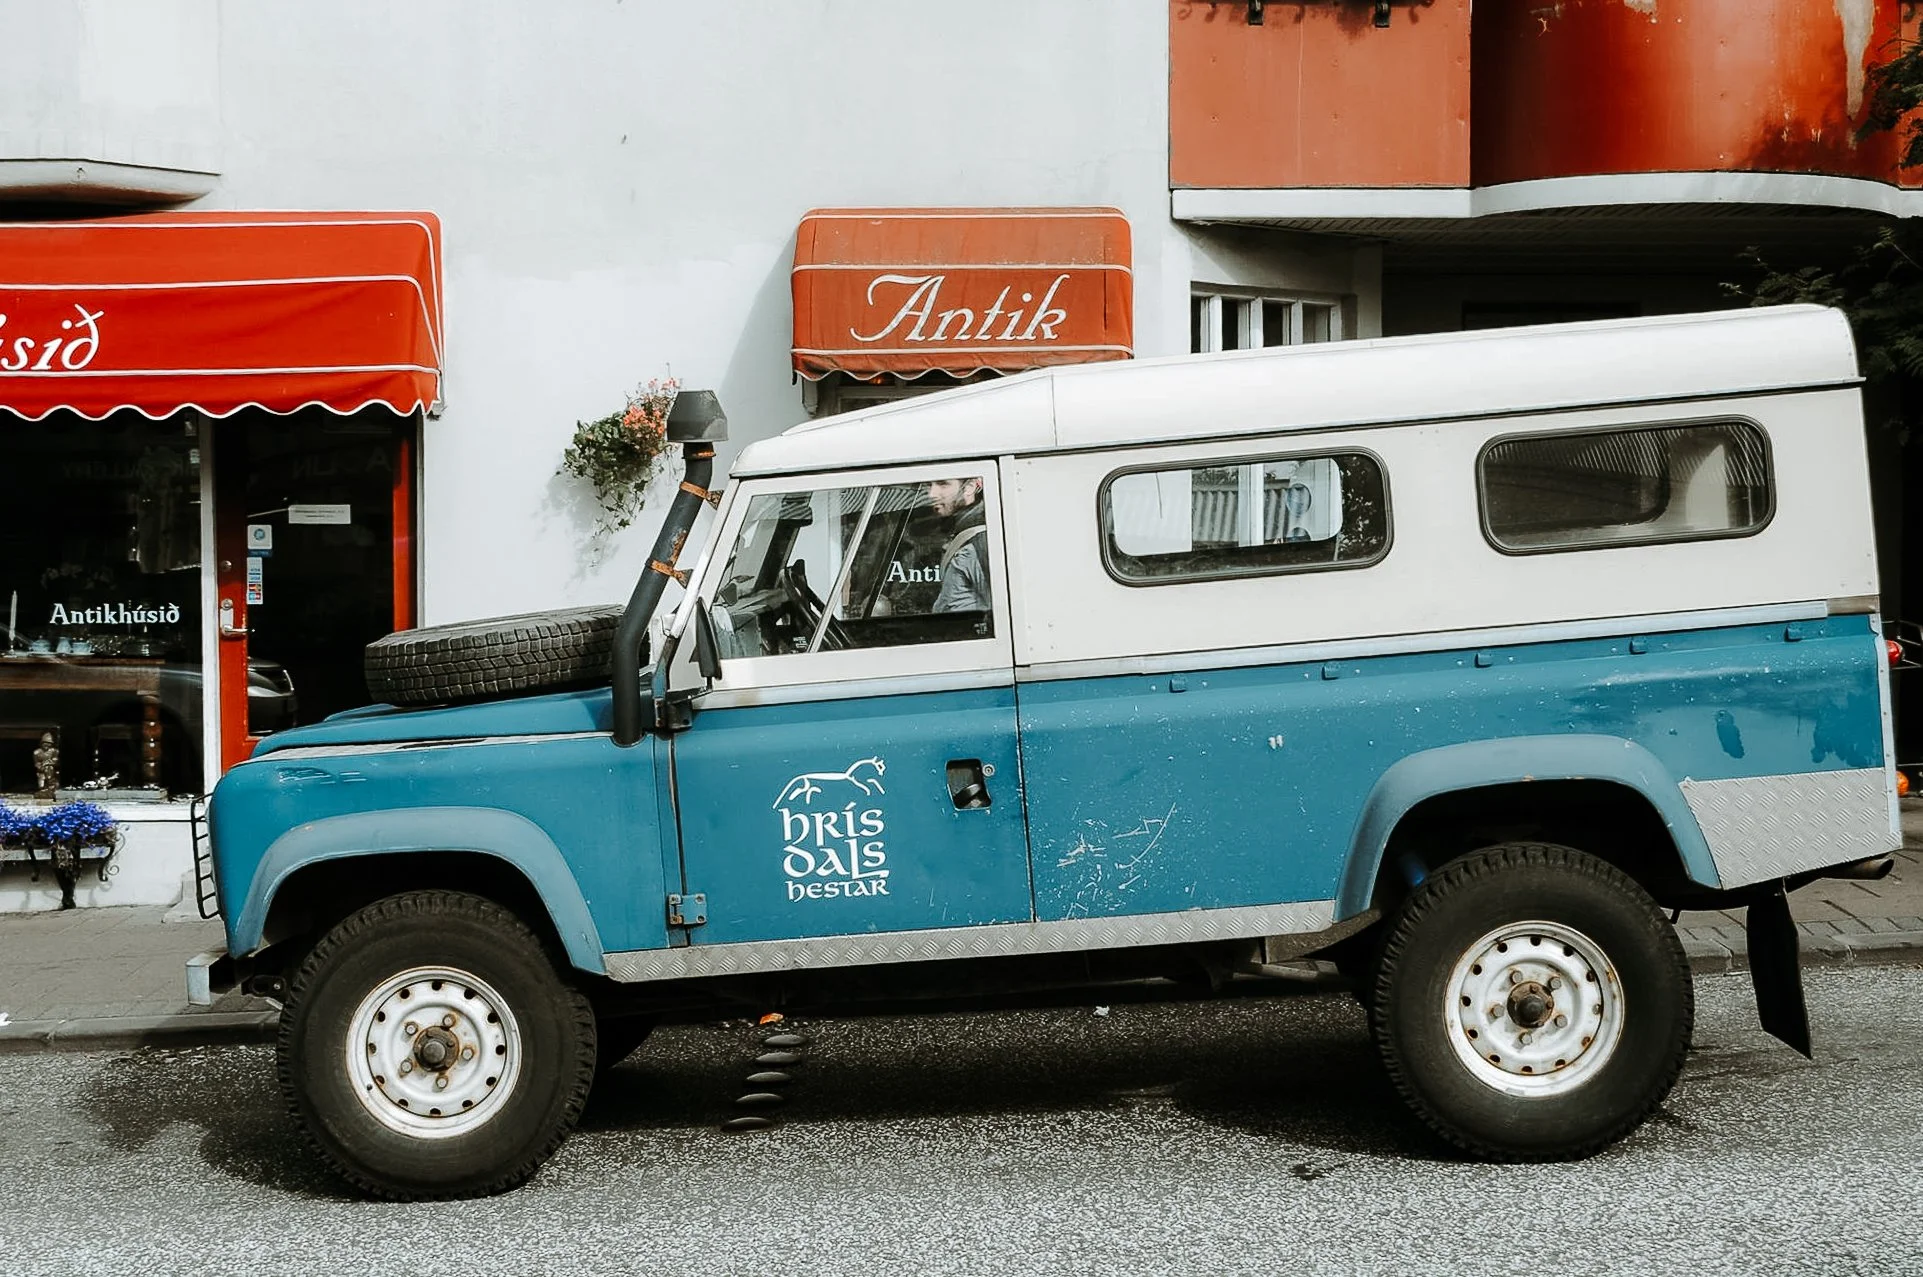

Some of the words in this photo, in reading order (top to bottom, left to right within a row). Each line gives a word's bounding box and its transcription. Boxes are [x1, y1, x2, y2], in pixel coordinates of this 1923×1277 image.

[0, 303, 105, 370] sið
[850, 274, 1070, 341] Antik
[49, 602, 180, 625] Antikhúsið
